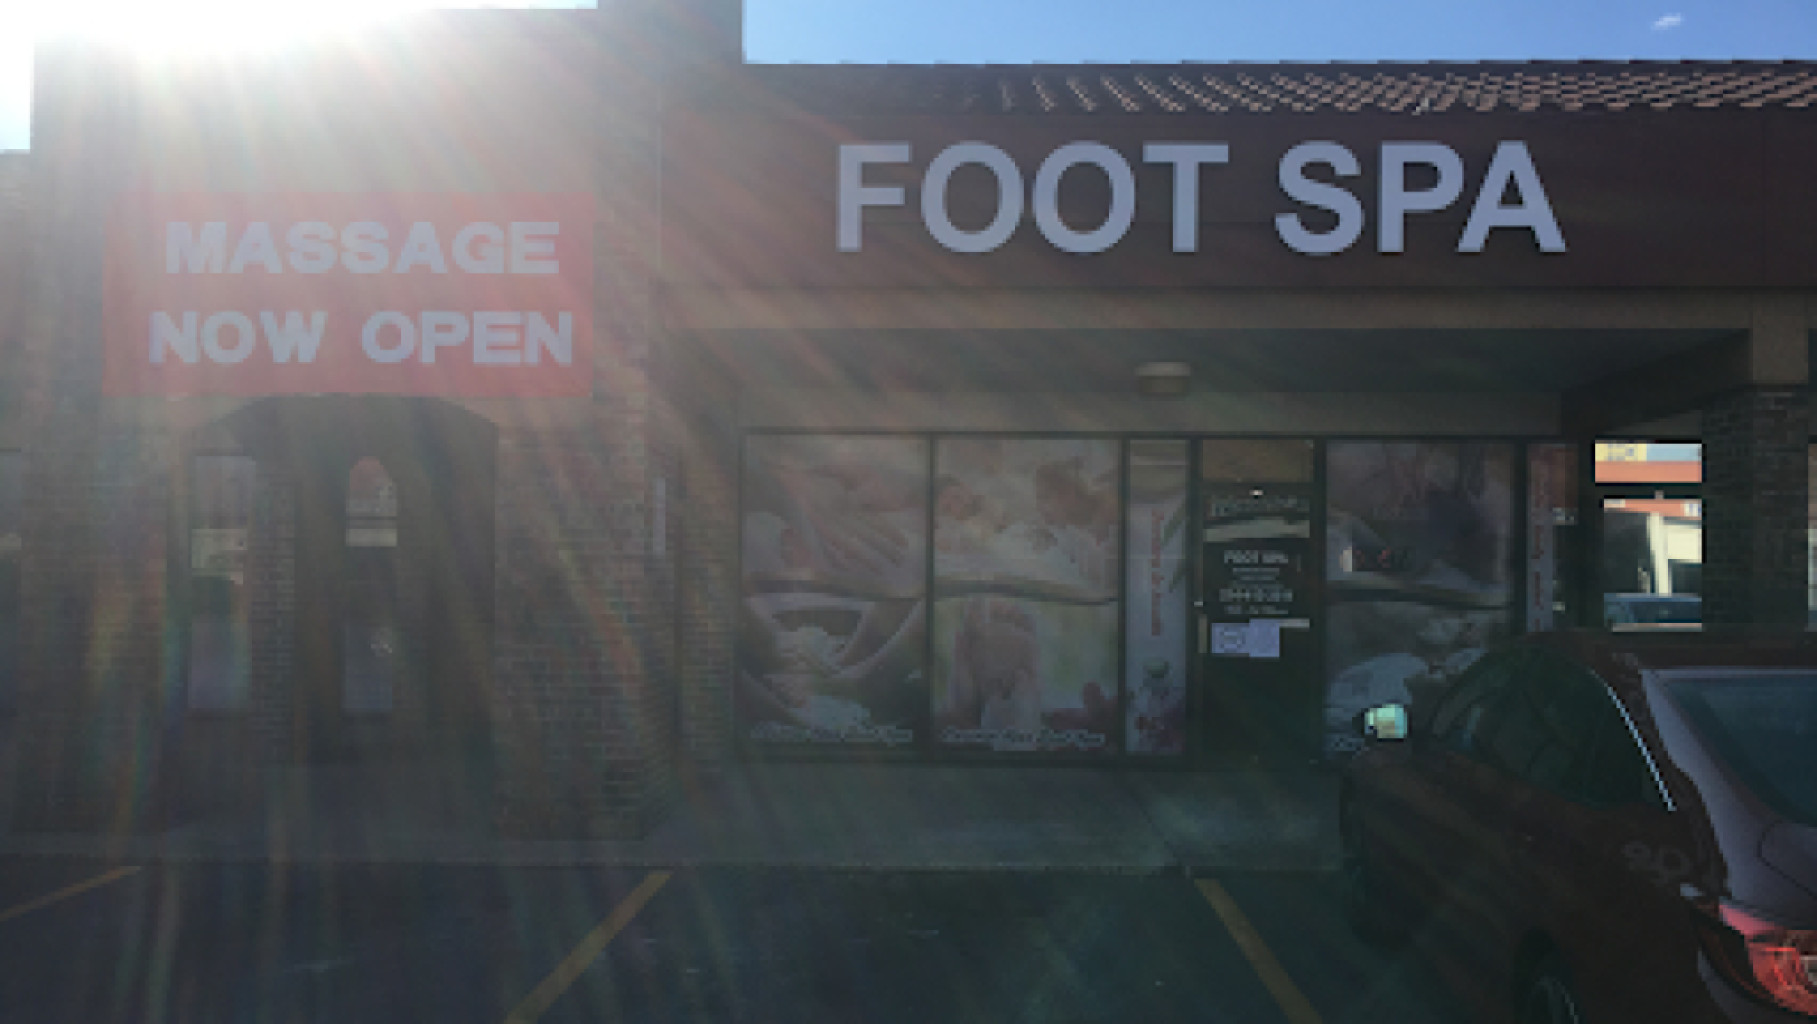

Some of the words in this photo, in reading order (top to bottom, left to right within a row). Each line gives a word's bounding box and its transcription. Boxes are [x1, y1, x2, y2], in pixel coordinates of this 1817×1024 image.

[837, 140, 1229, 254] FOOT
[1274, 140, 1567, 255] SPA
[165, 221, 560, 274] MASSAGE
[149, 310, 327, 365] NOW
[361, 310, 573, 366] OPEN
